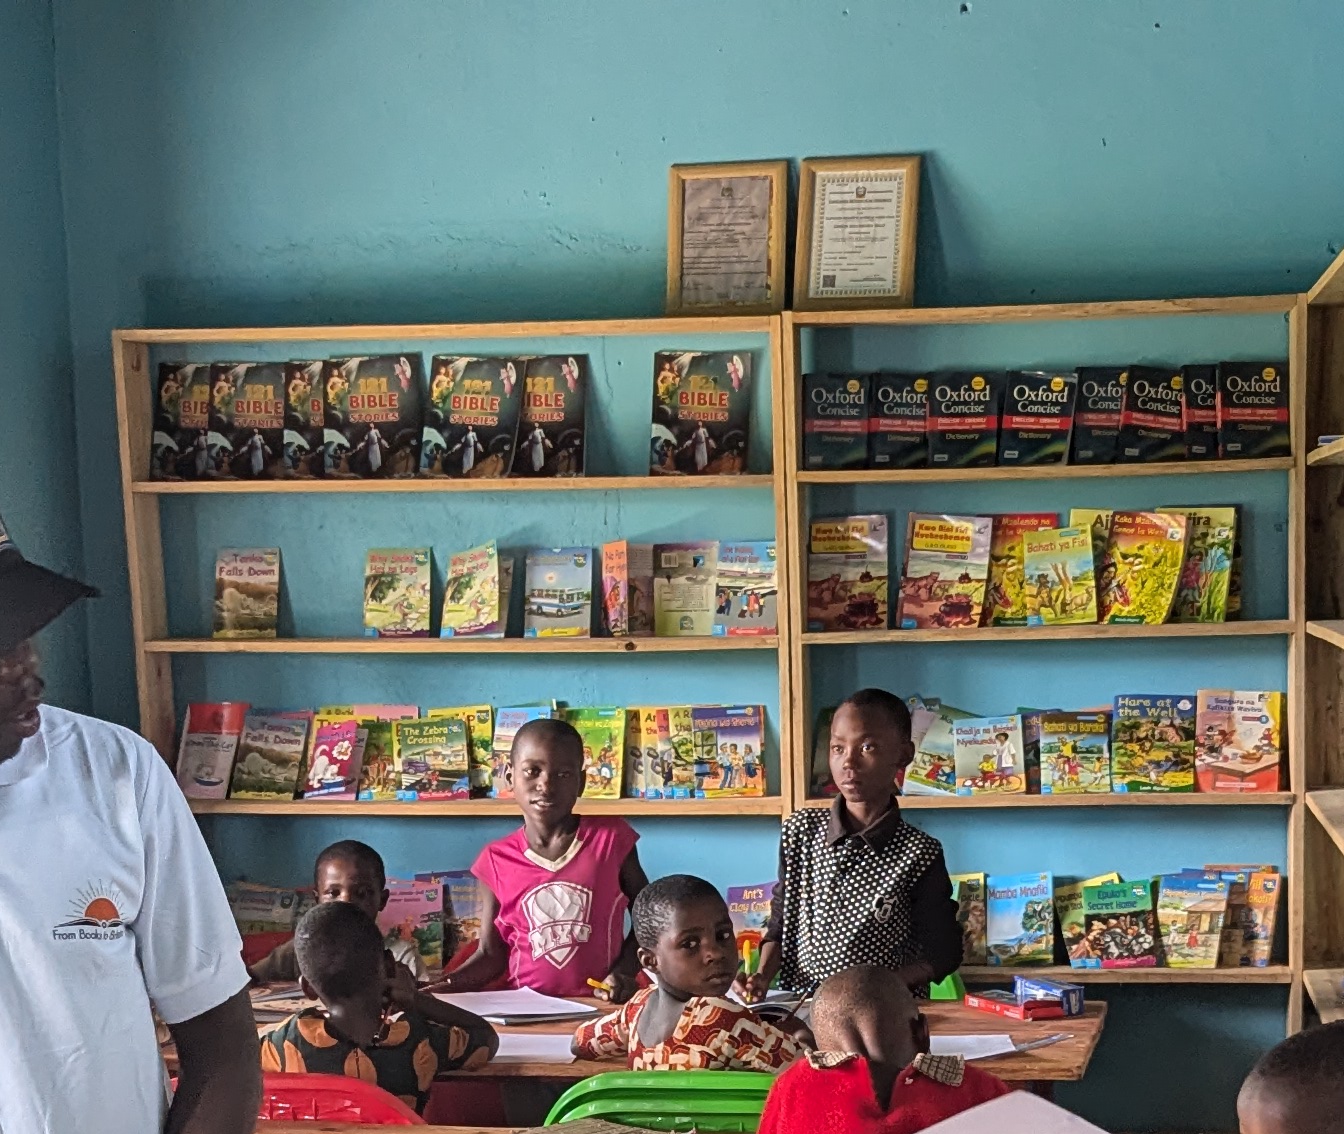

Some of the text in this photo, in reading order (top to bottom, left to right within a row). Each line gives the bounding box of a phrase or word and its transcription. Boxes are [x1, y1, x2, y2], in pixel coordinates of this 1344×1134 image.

[1227, 376, 1281, 392] Oxford
[811, 388, 865, 405] Oxford
[935, 385, 990, 401] Oxford
[1013, 385, 1068, 403] Oxford
[1232, 393, 1275, 404] Concise
[348, 393, 398, 409] BIBLE
[451, 394, 500, 412] BIBLE
[678, 391, 729, 408] BIBLE
[234, 400, 284, 415] BIBLE
[817, 404, 860, 415] Concise
[883, 403, 926, 415] Concise
[941, 402, 984, 414] Concise
[1017, 401, 1061, 414] Concise
[1138, 398, 1180, 414] Concise
[349, 412, 399, 422] STORIES
[449, 414, 498, 426] STORIES
[678, 410, 728, 421] STORIES
[234, 417, 284, 428] STORIES
[1027, 537, 1088, 552] Bahati ya Fisi
[219, 566, 276, 576] Falls Down
[1118, 698, 1172, 708] Hare at
[1118, 707, 1177, 718] the Well
[403, 726, 448, 736] The Zebra
[246, 733, 270, 744] Falls
[274, 734, 301, 746] Down
[407, 736, 446, 744] Crossing
[988, 889, 1017, 899] Mamba
[1087, 902, 1114, 911] Secret
[53, 930, 76, 940] From
